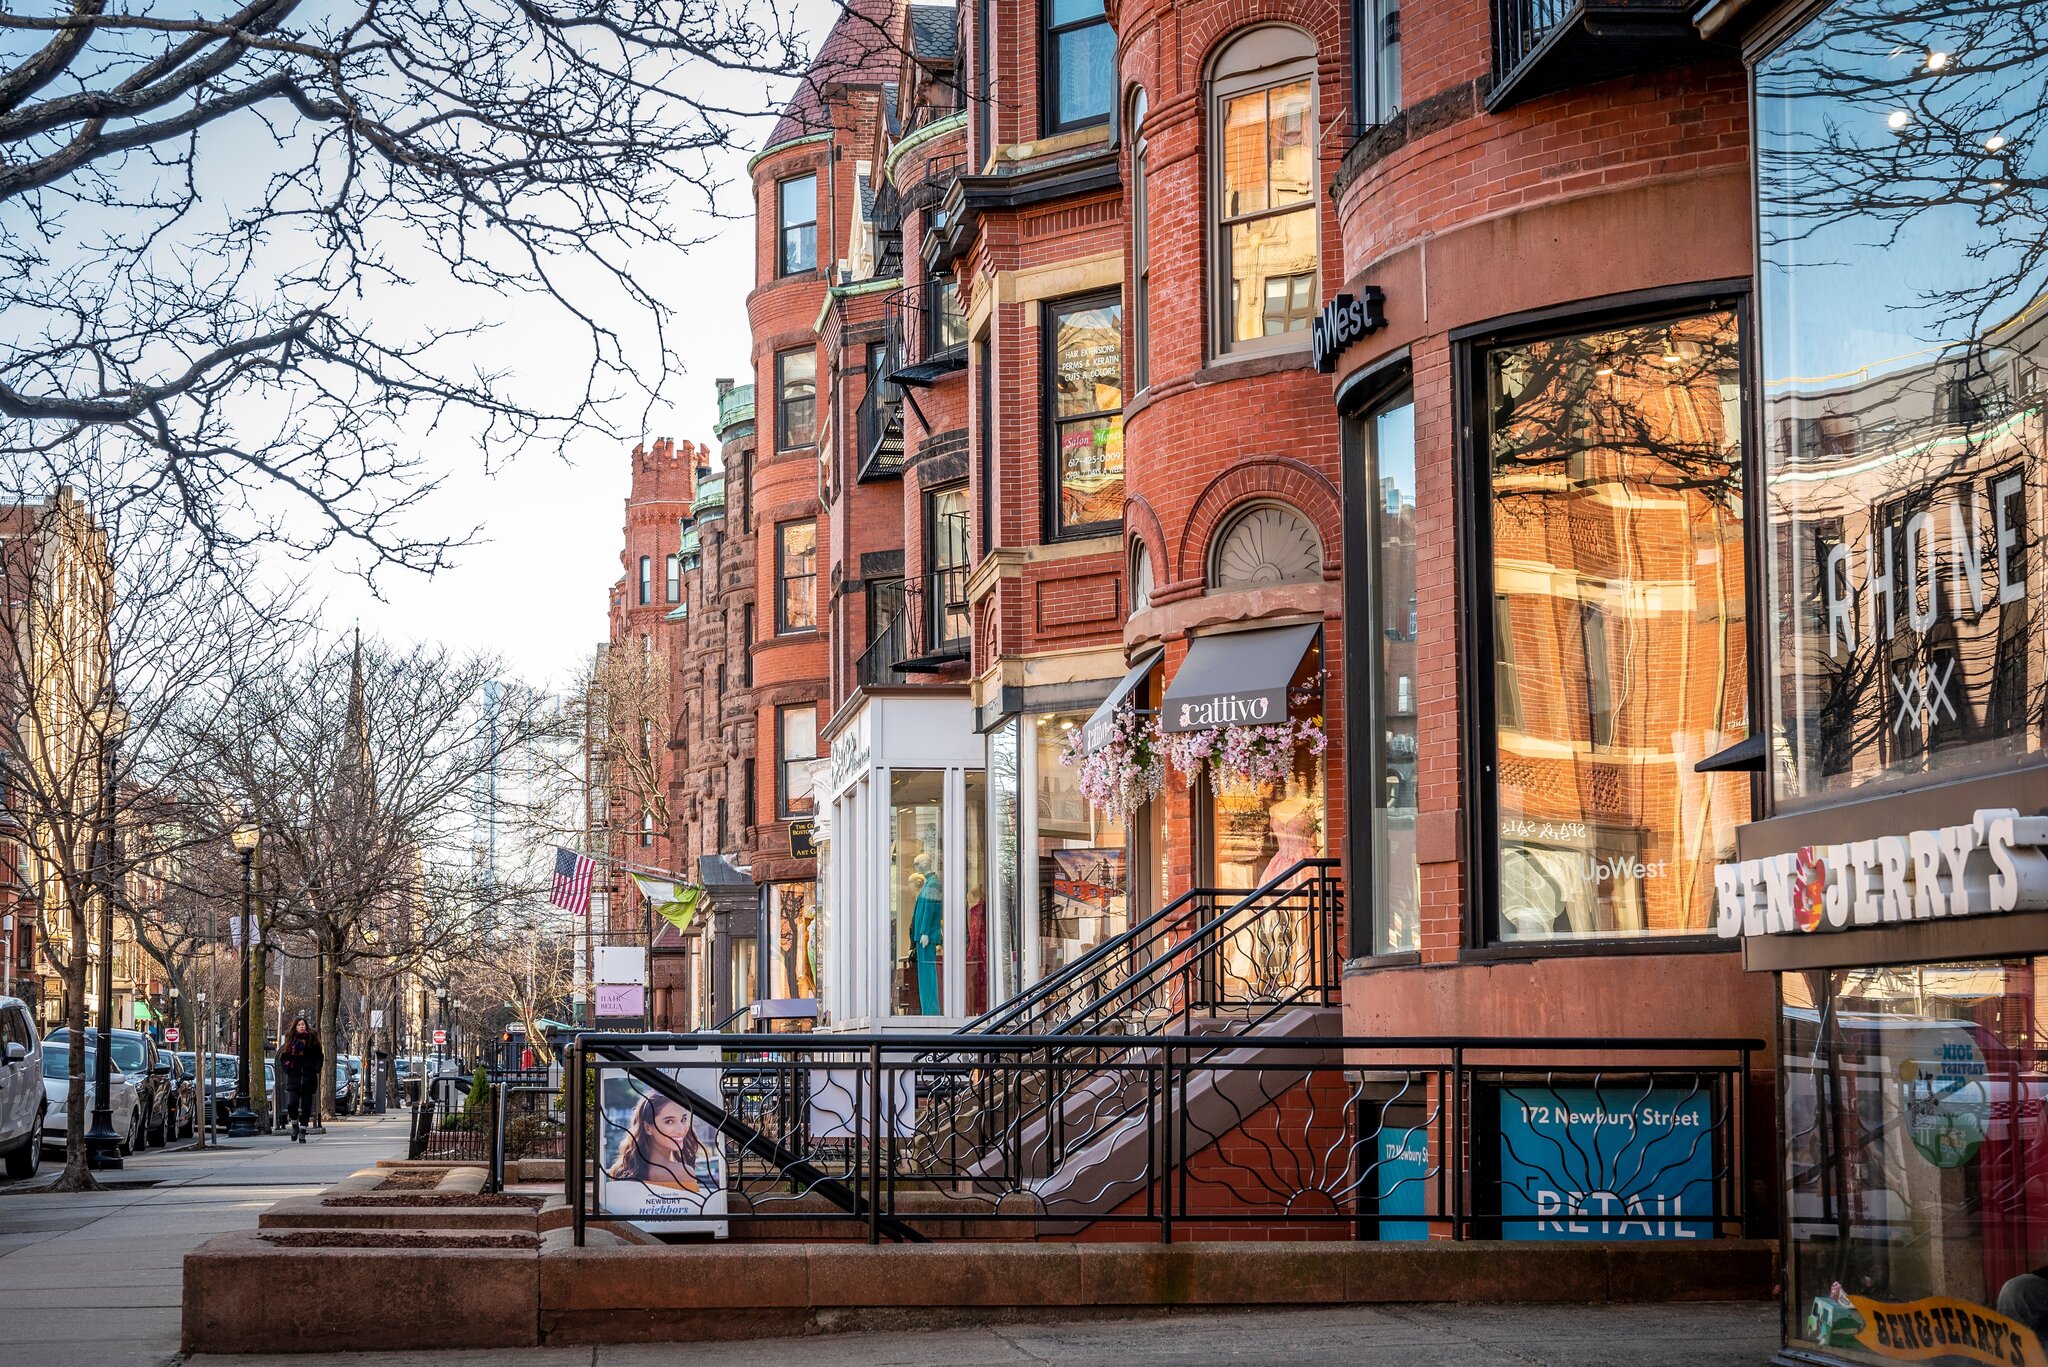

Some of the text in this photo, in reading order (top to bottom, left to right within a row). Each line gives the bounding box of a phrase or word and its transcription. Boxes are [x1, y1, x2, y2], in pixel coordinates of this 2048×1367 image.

[1065, 344, 1115, 359] HAIR EXTENSIONS
[1062, 354, 1120, 371] PERMS & KERATIN
[1064, 373, 1080, 382] CUTS
[1090, 366, 1116, 378] COLORS
[1066, 434, 1089, 448] Salon
[1827, 474, 2026, 658] RHONE
[1185, 695, 1268, 727] cattivo
[1580, 856, 1667, 886] UpWest
[1521, 1106, 1700, 1130] 172 Newbury Street
[639, 1205, 688, 1215] neighbors
[1538, 1190, 1696, 1238] RETAIL
